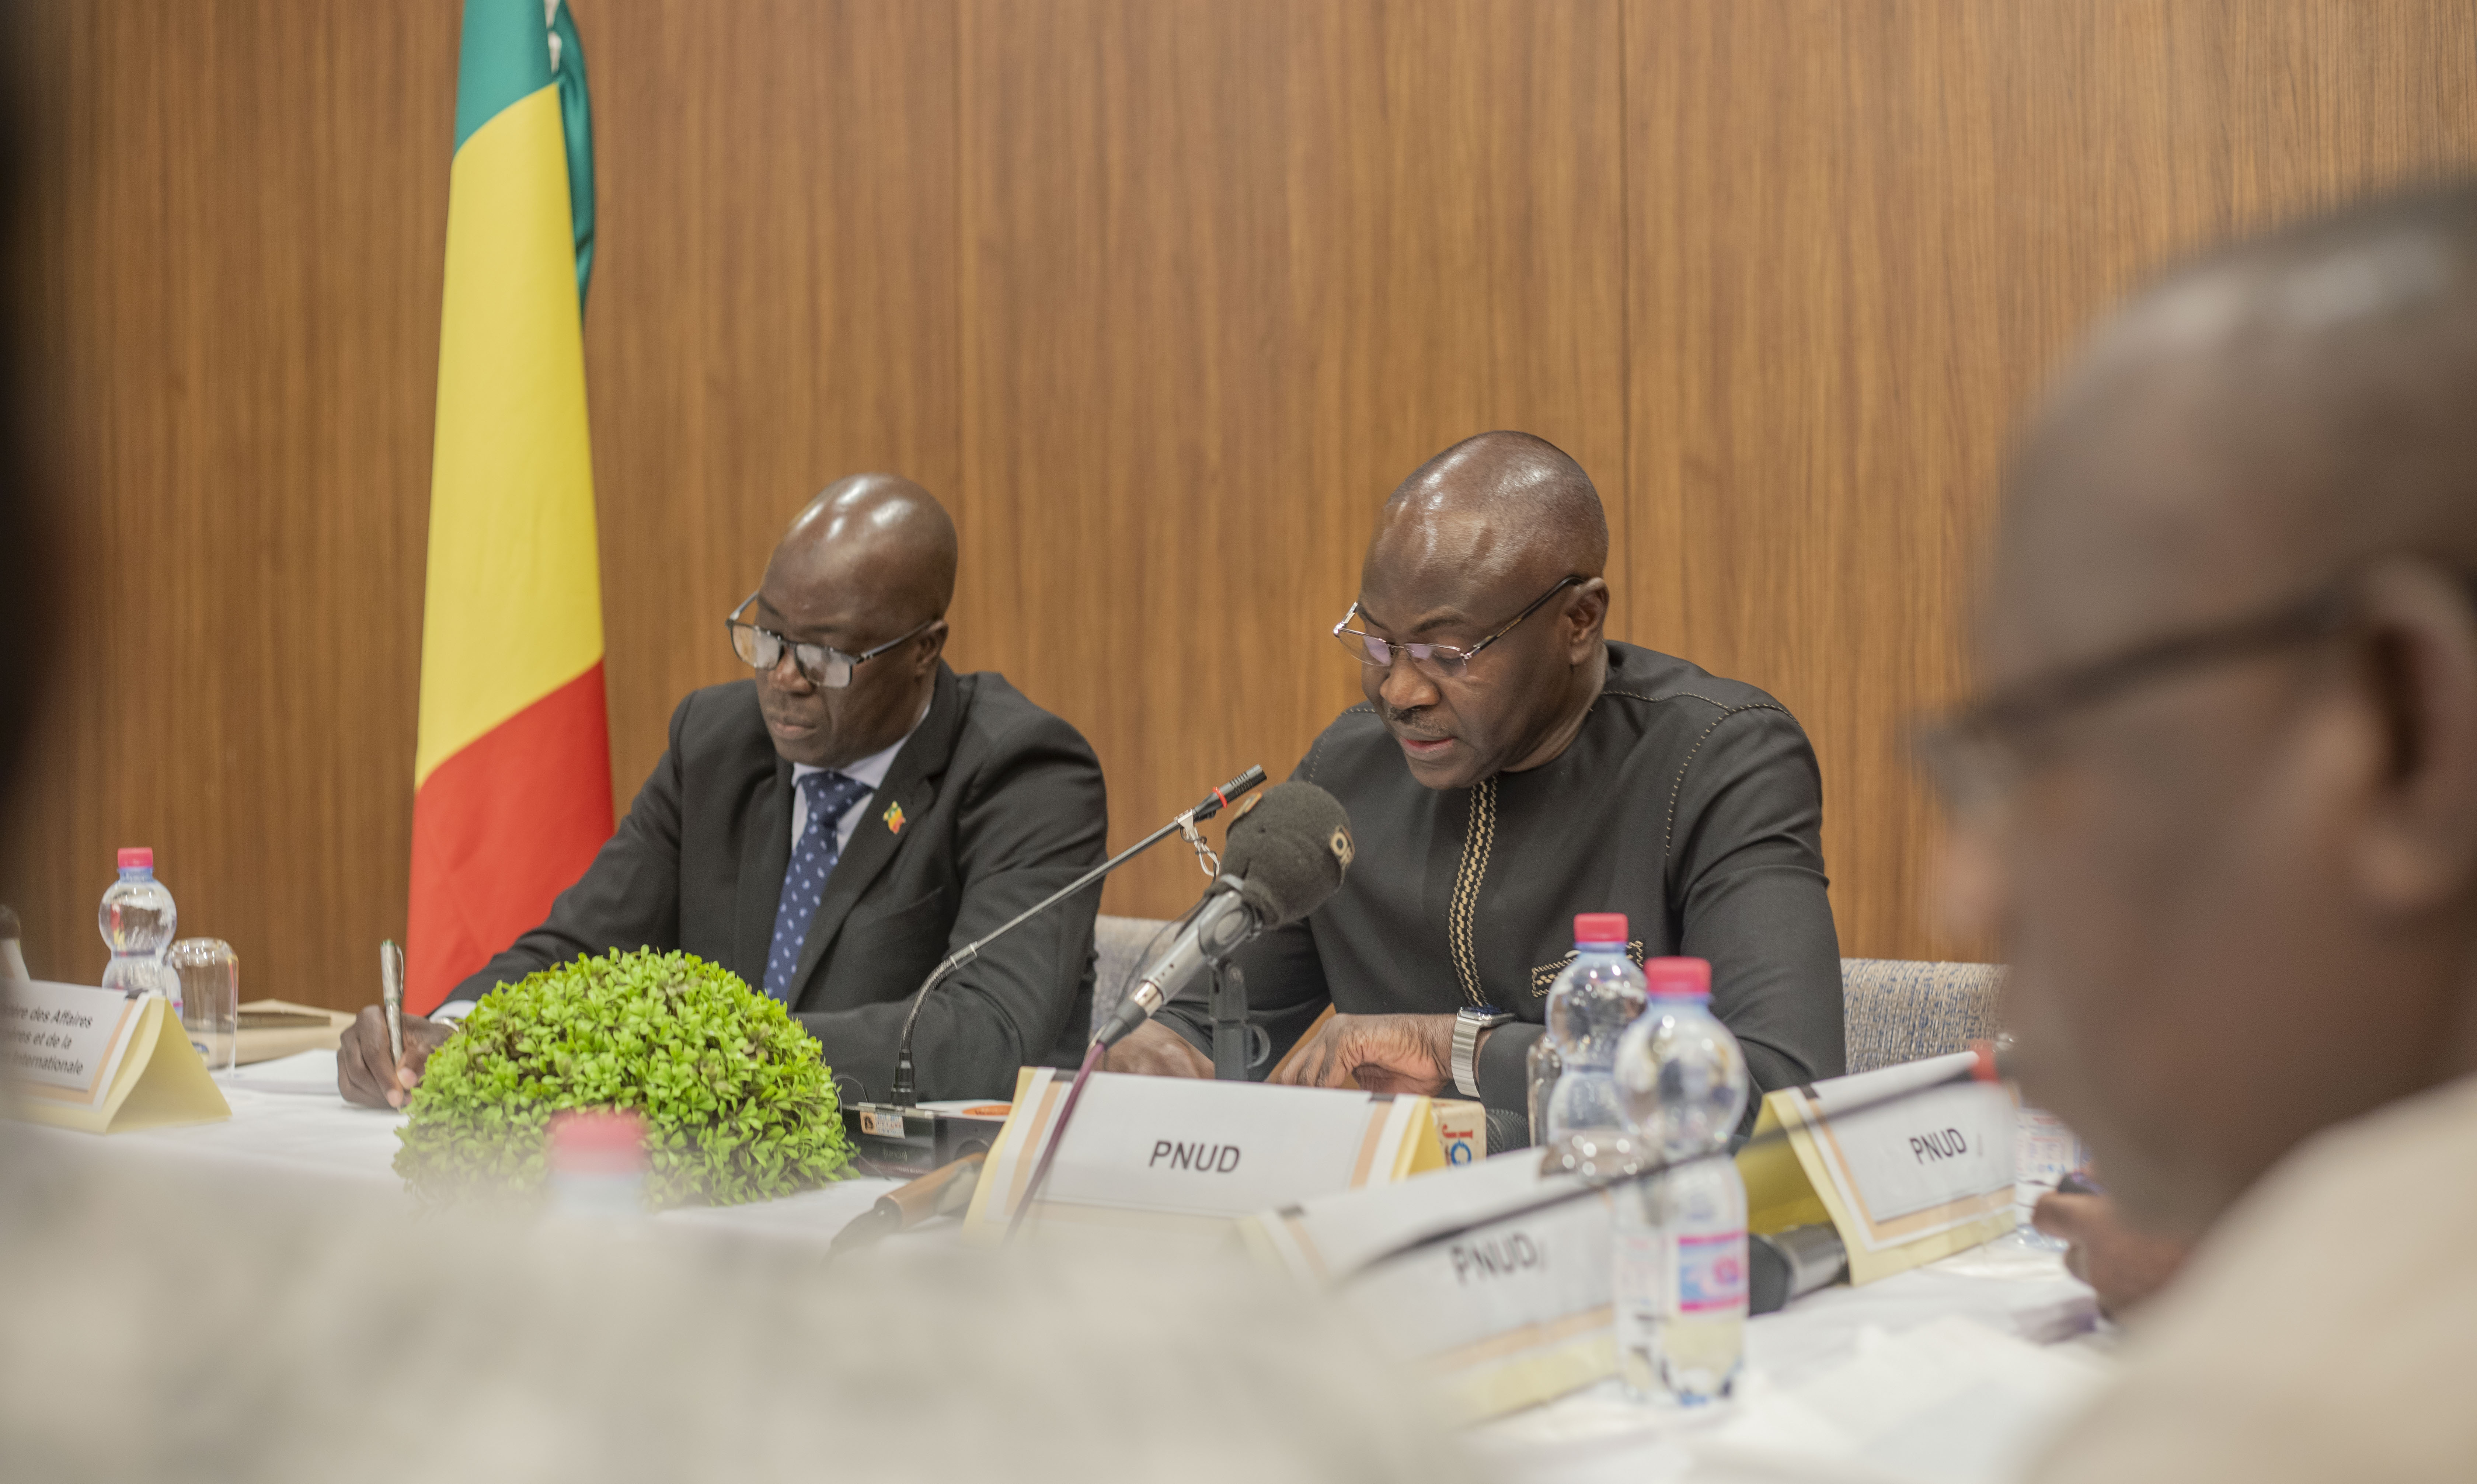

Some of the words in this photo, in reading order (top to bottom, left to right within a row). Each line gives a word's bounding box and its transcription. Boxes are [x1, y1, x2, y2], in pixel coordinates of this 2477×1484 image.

[30, 1006, 50, 1023] des
[50, 1009, 93, 1028] Affaires
[33, 1032, 45, 1046] et
[46, 1032, 60, 1048] de
[61, 1034, 72, 1050] la
[1149, 1140, 1240, 1172] PNUD
[1909, 1128, 1966, 1165] PNUD
